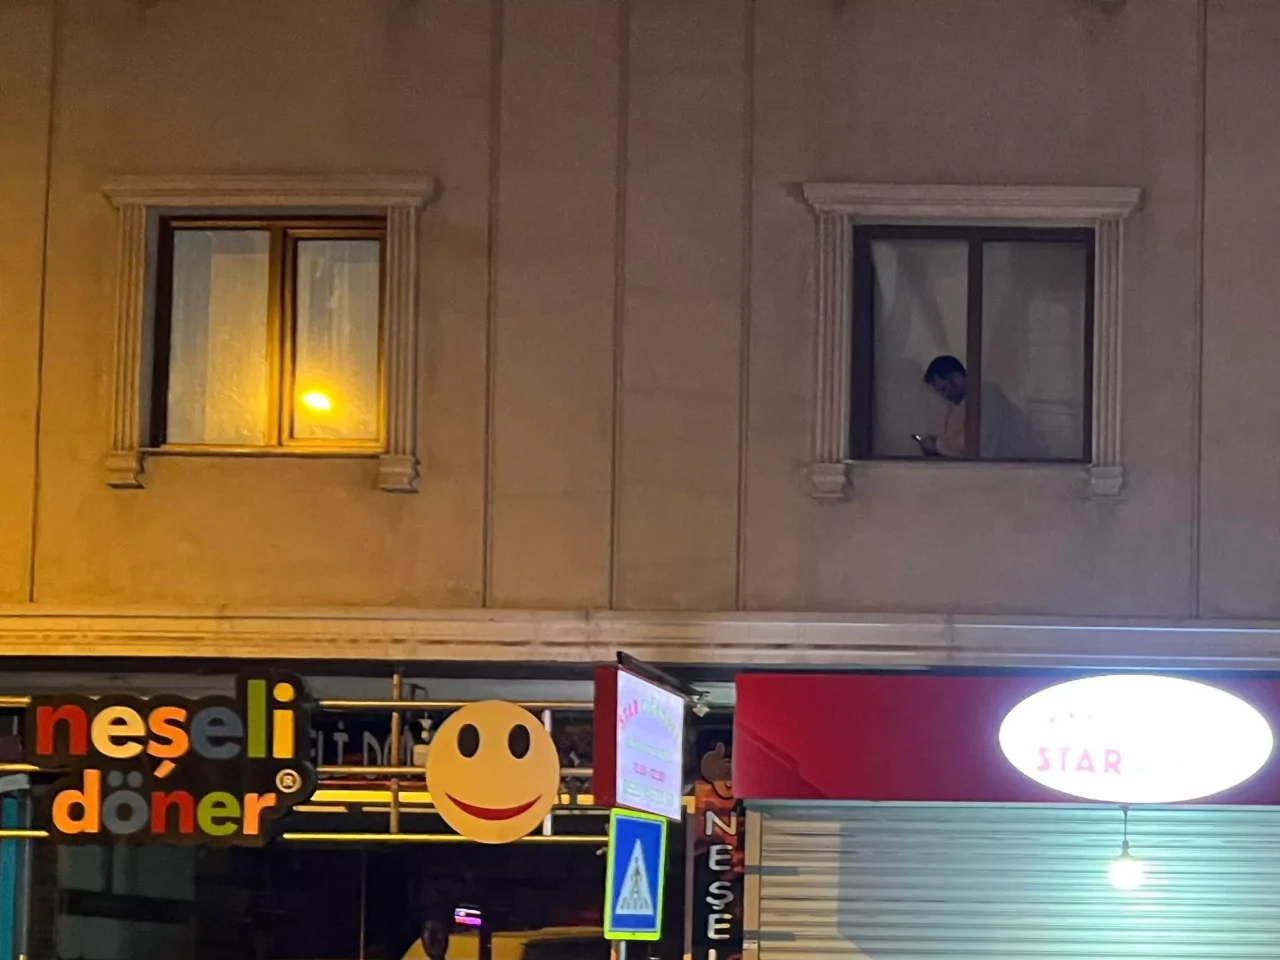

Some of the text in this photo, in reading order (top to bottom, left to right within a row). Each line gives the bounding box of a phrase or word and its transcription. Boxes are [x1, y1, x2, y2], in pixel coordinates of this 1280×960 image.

[36, 679, 296, 778] neşeli
[1036, 746, 1122, 775] STAR
[52, 768, 277, 837] döner
